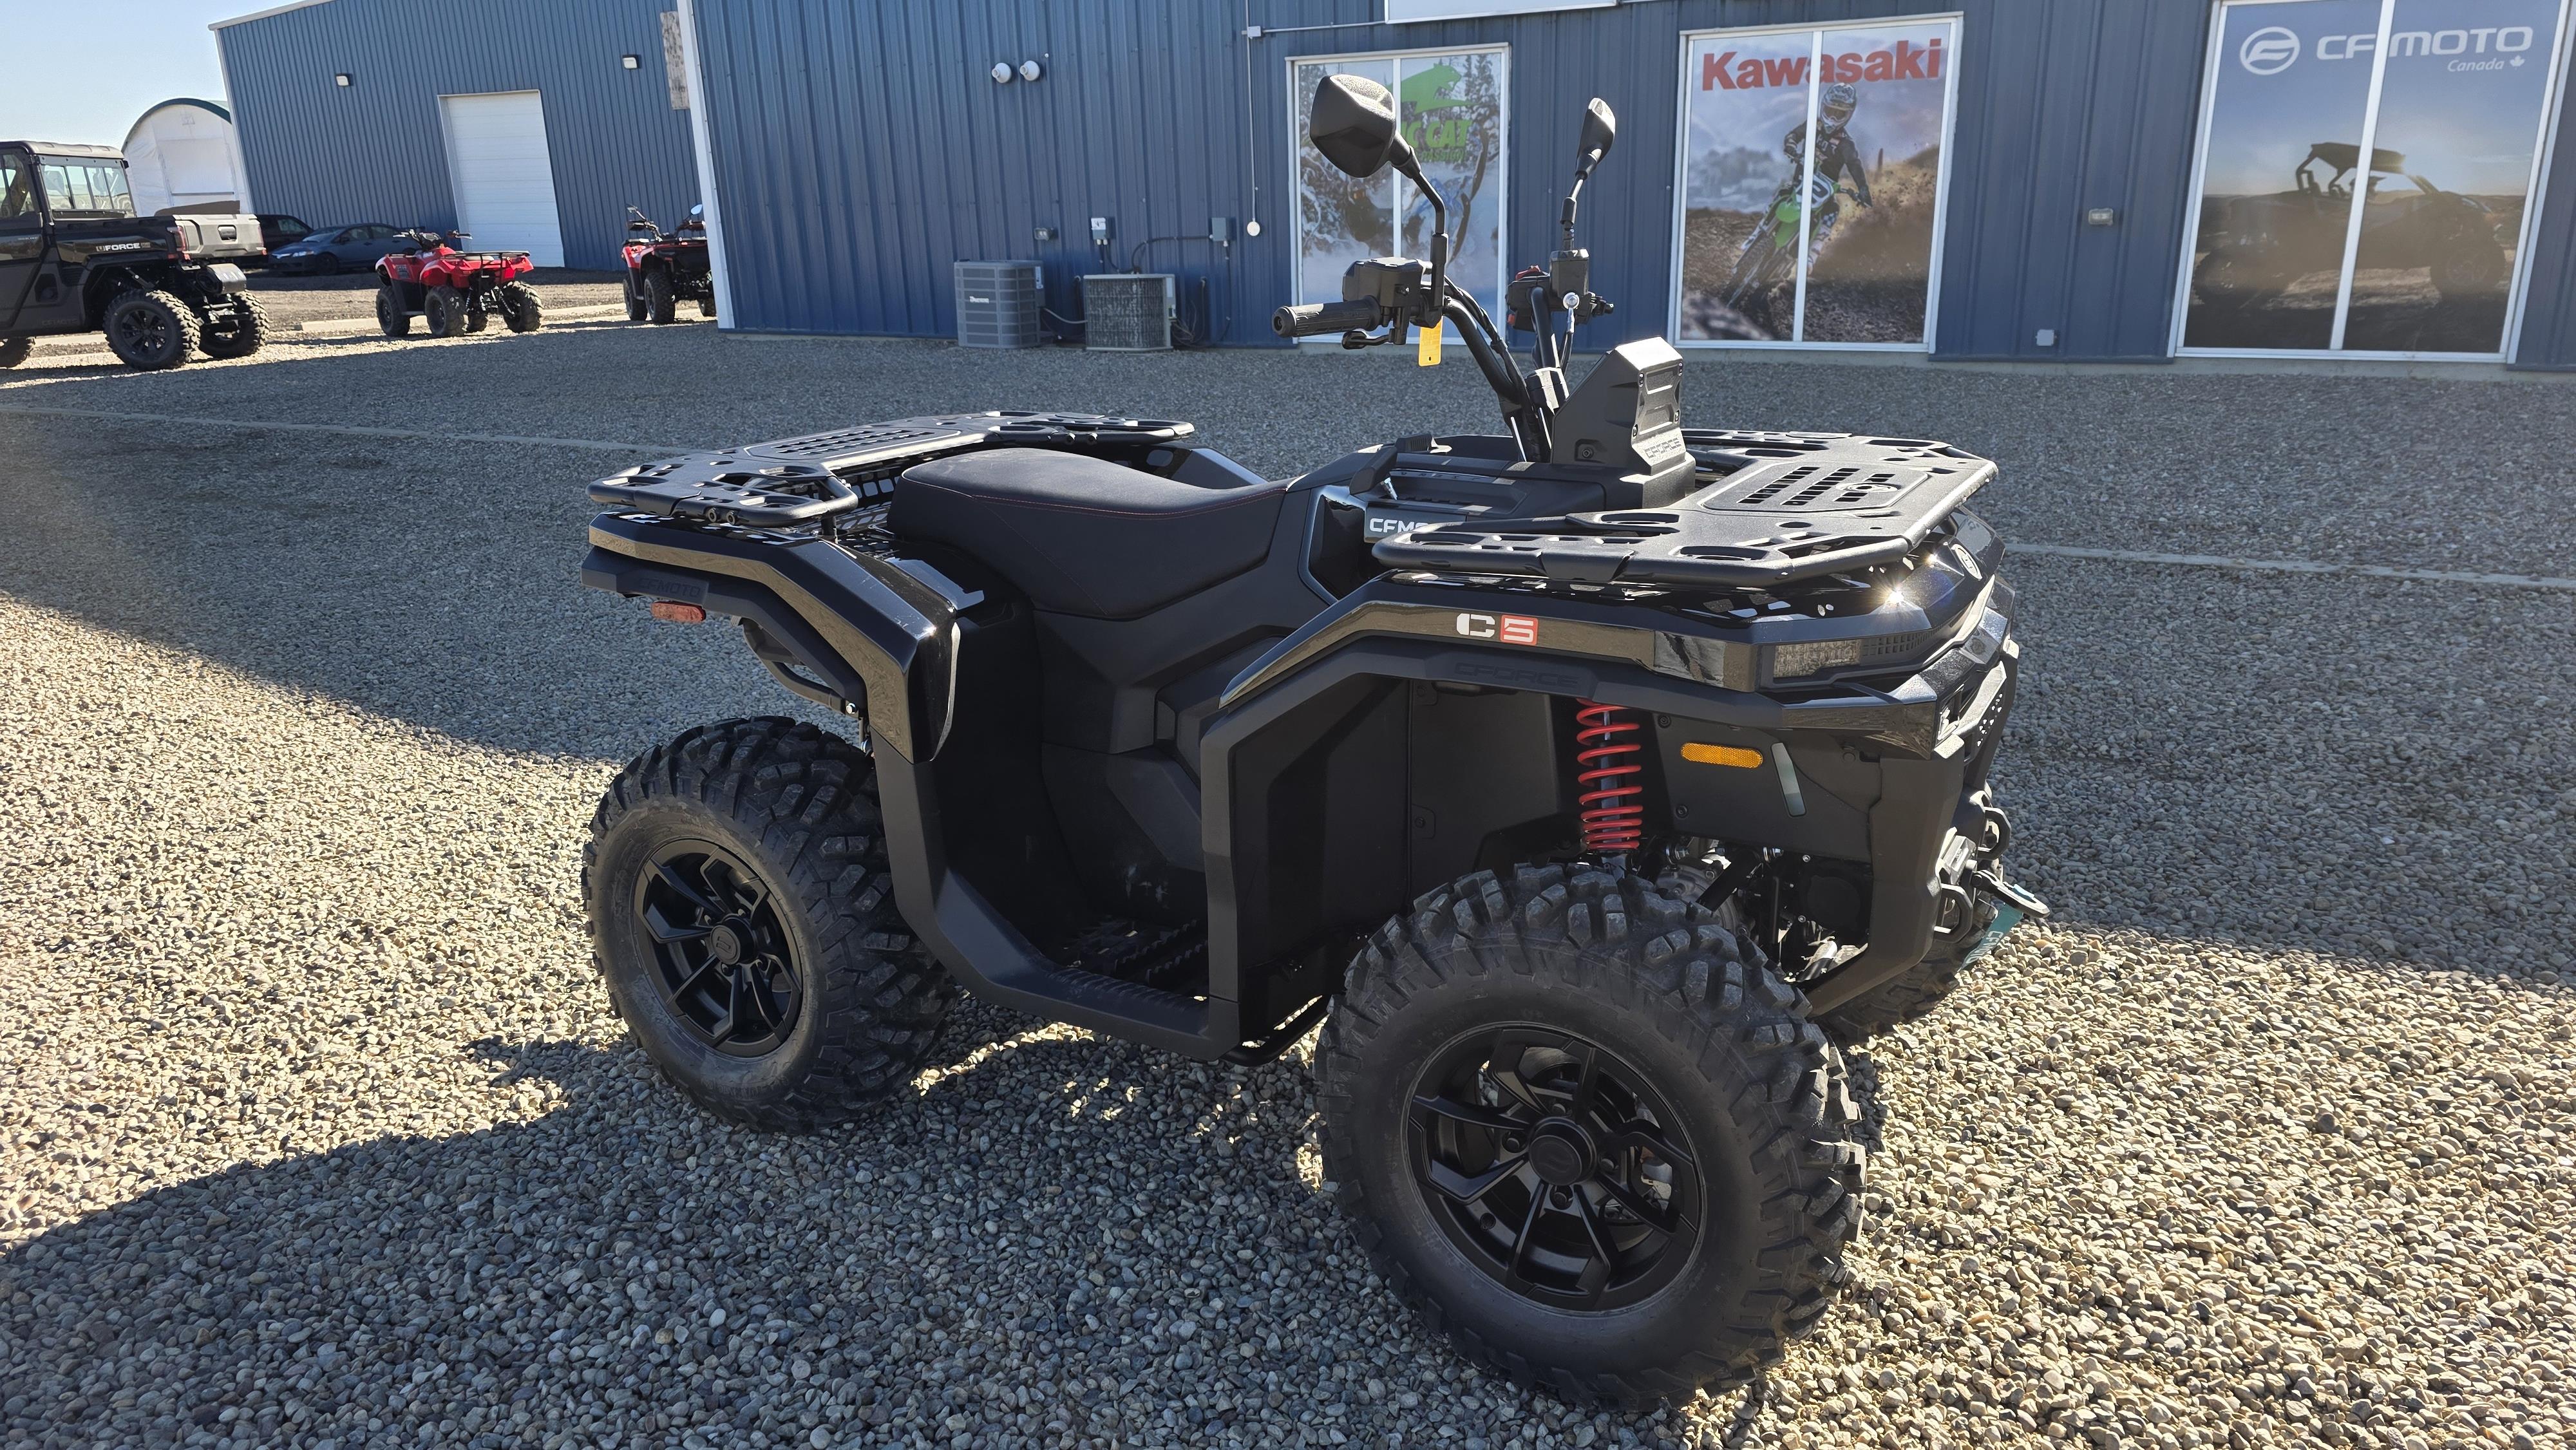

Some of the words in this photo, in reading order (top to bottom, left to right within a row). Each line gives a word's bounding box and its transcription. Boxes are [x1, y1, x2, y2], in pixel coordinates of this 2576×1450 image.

[1702, 38, 1942, 91] Kawasaki
[2447, 59, 2505, 73] Canada
[1426, 119, 1472, 148] CAT
